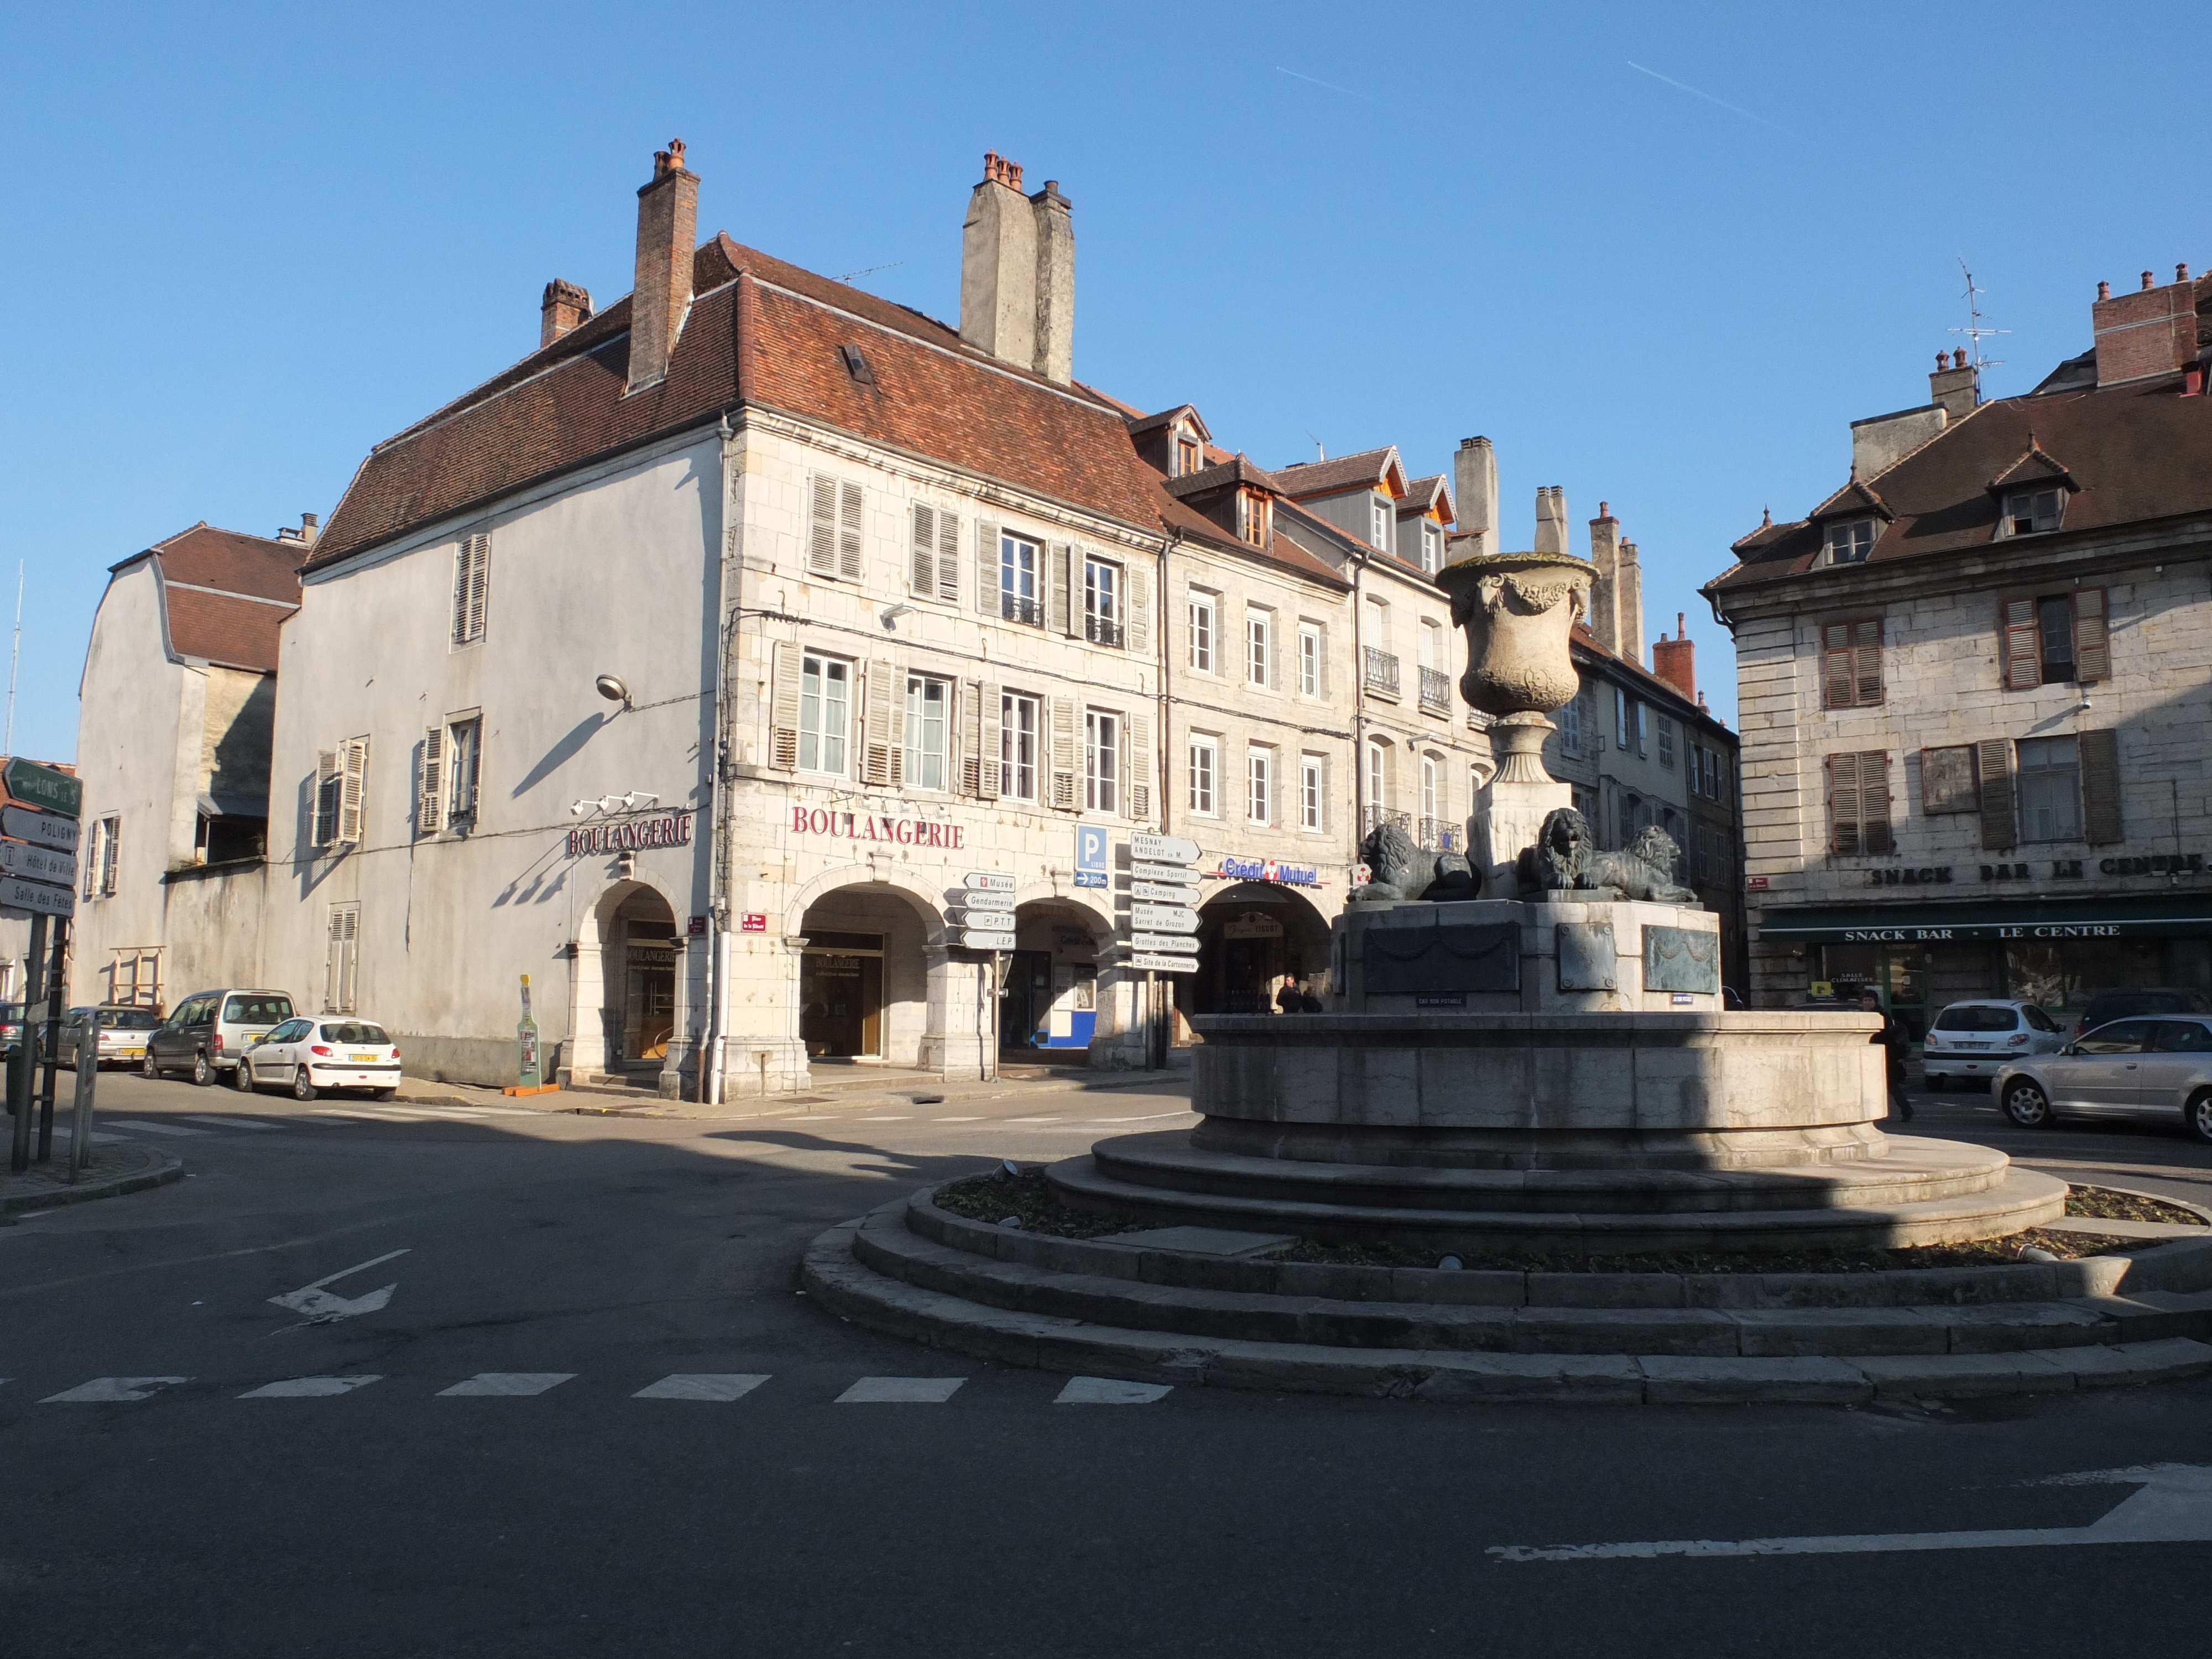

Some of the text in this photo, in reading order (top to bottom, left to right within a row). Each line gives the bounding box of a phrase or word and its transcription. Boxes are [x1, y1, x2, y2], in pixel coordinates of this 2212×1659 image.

[41, 821, 77, 842] POLIGNY
[791, 806, 966, 850] BOULANGERIE
[569, 815, 693, 855] BOULANGERIE
[1134, 836, 1161, 846] MESNAY
[1085, 833, 1099, 862] P
[1134, 846, 1165, 857] ANDELOT
[27, 854, 75, 876] Hôtel de Ville
[1225, 858, 1317, 883] Crédit Mutuel
[1135, 866, 1187, 878] Complexe Sportif
[1871, 867, 1953, 884] SNACK
[1979, 863, 2030, 881] BAR
[2053, 860, 2083, 879] LE
[989, 878, 1013, 888] Musée
[1090, 876, 1107, 885] 200m
[15, 886, 72, 909] Salle des Fêtes
[1150, 888, 1176, 899] Camping
[971, 896, 1013, 907] Gendarmerie
[1135, 906, 1185, 918] Musée MJC
[1135, 917, 1152, 926] Sarret
[1165, 920, 1185, 928] Grozon
[1845, 925, 2120, 941] SNACK BAR LE CENTRE
[997, 937, 1013, 945] L.E.P.
[1135, 937, 1156, 946] Grottes
[1171, 940, 1195, 948] Planches
[816, 957, 859, 969] BOULANGERIE
[1144, 958, 1154, 966] Site
[1167, 960, 1195, 969] Cartonnerie
